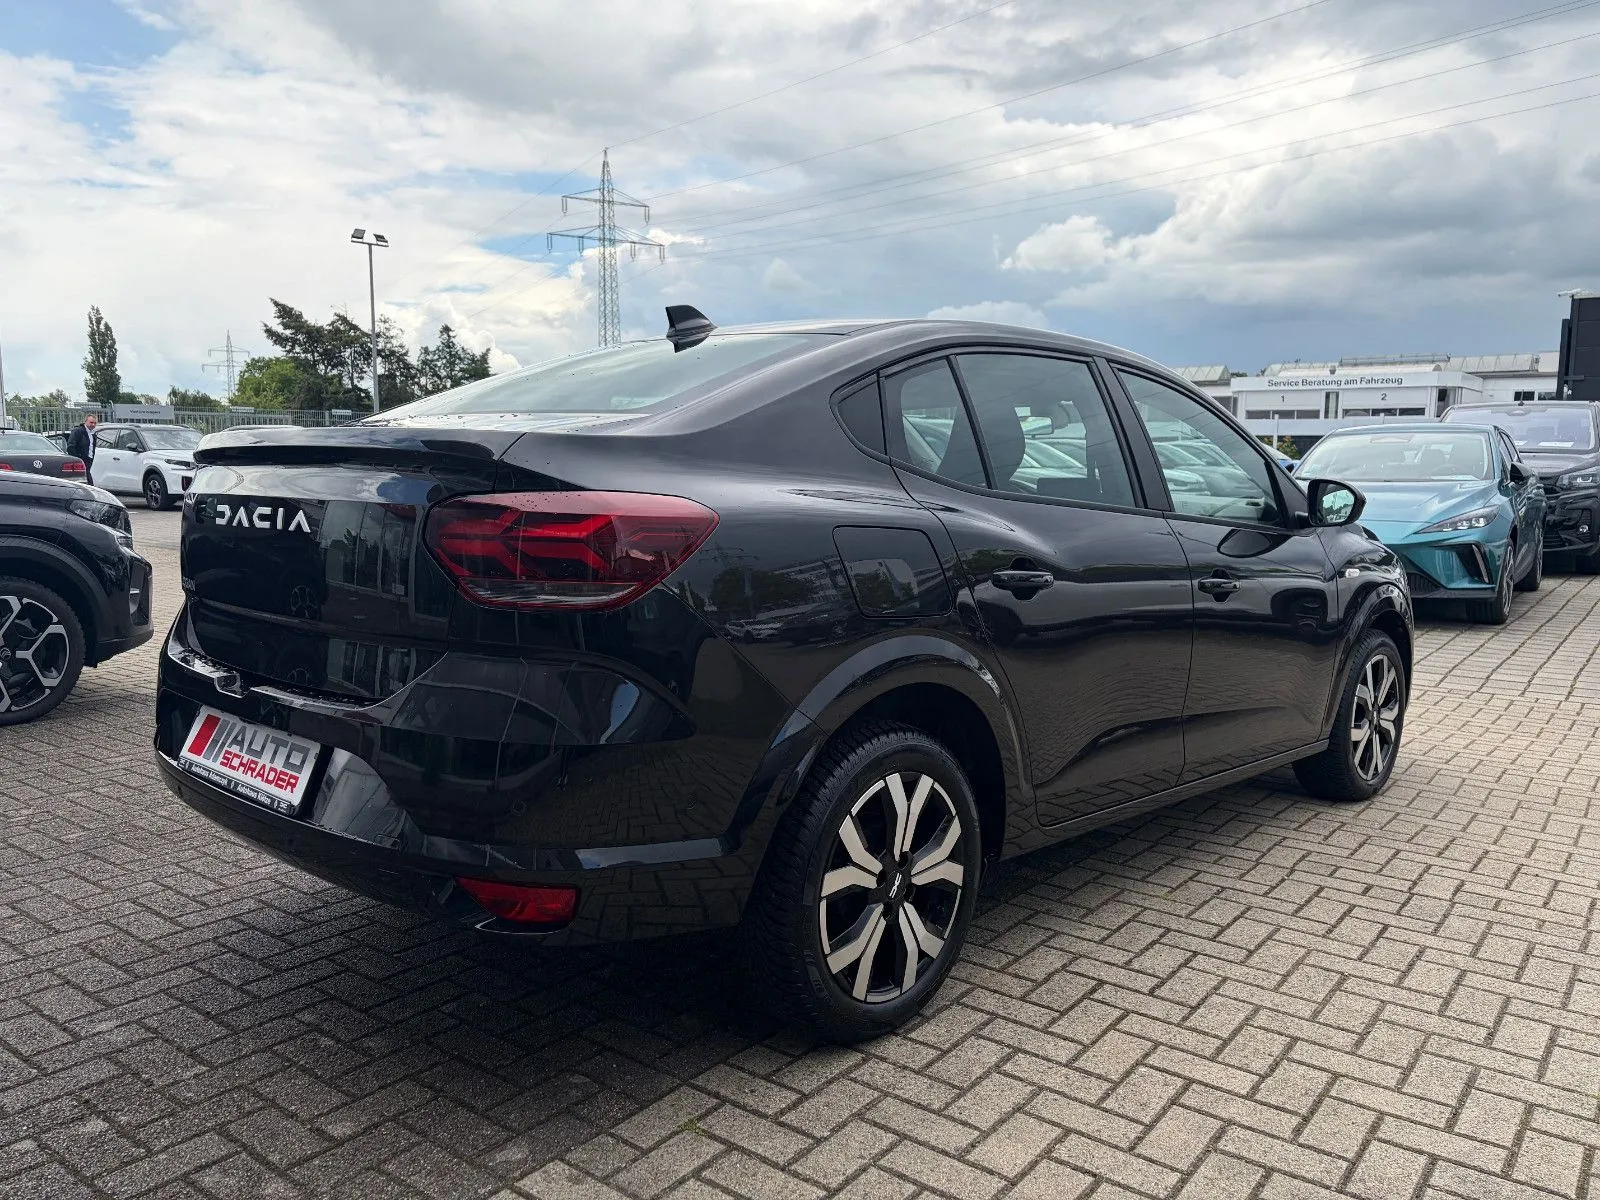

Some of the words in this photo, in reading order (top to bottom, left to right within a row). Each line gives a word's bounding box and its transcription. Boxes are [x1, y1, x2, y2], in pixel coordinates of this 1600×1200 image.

[1267, 379, 1300, 387] Service
[1301, 378, 1342, 388] Beratung
[1344, 378, 1358, 386] am
[1359, 376, 1403, 385] Fahrzeug
[1381, 392, 1388, 401] 2
[1280, 394, 1285, 403] 1
[215, 504, 311, 533] DACIA
[226, 725, 311, 775] AUTO
[190, 764, 209, 778] Autohaus
[236, 784, 258, 798] Autohaus
[219, 749, 300, 794] SCHRADER
